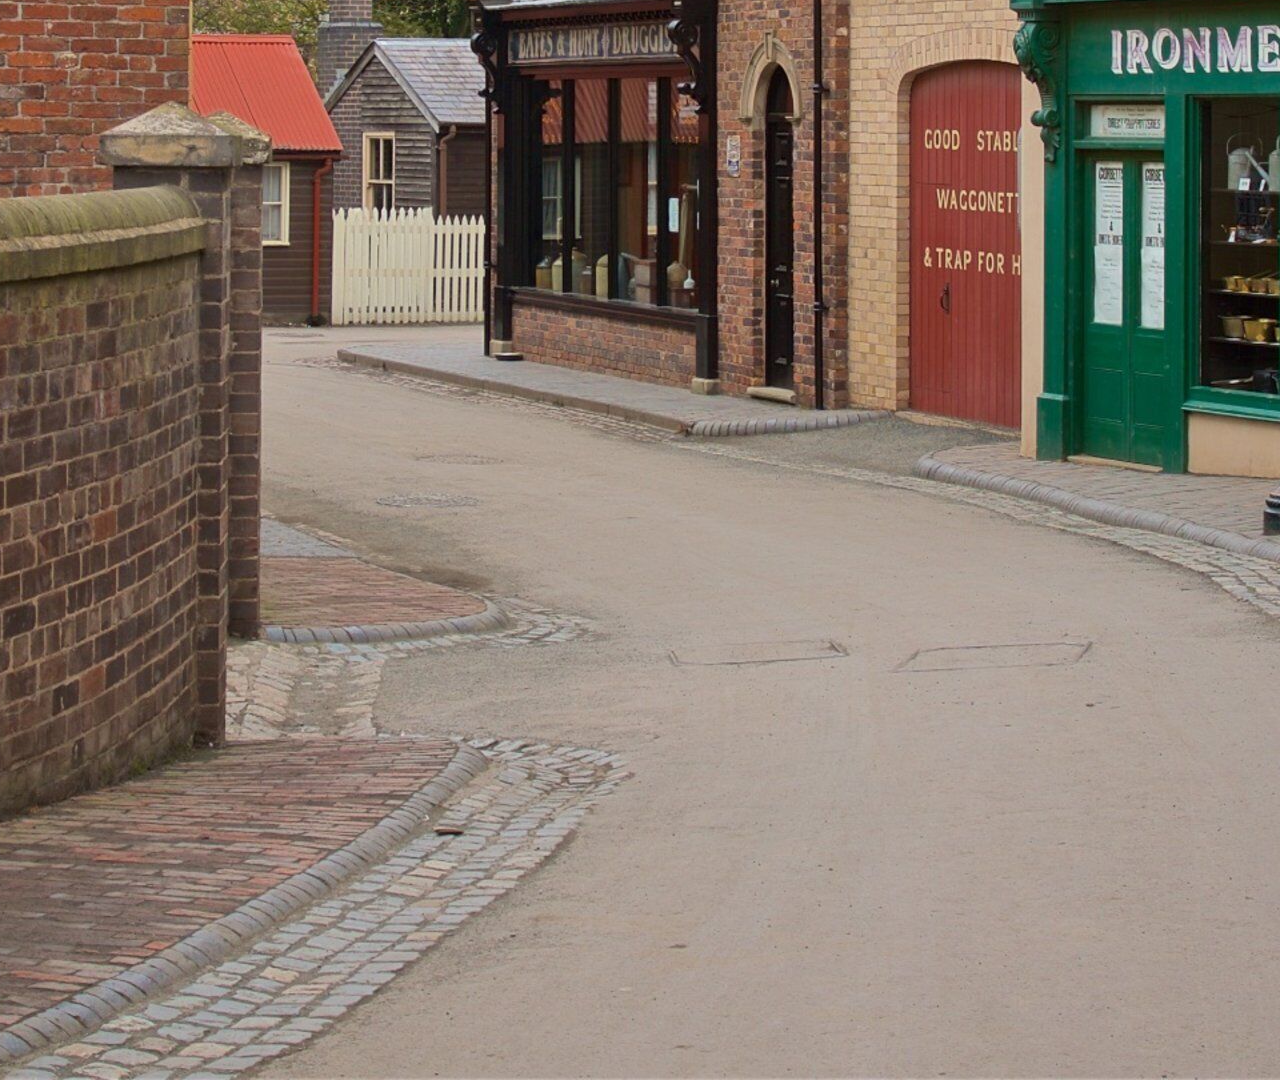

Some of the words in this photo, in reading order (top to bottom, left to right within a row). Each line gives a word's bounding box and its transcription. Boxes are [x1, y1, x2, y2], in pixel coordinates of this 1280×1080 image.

[518, 31, 552, 59] BATES
[556, 30, 565, 56] &
[570, 27, 599, 57] HUNT
[613, 24, 678, 54] DRUGGIS
[924, 129, 961, 151] GOOD
[924, 247, 933, 268] &
[936, 247, 972, 270] TRAP
[977, 251, 1005, 274] FOR
